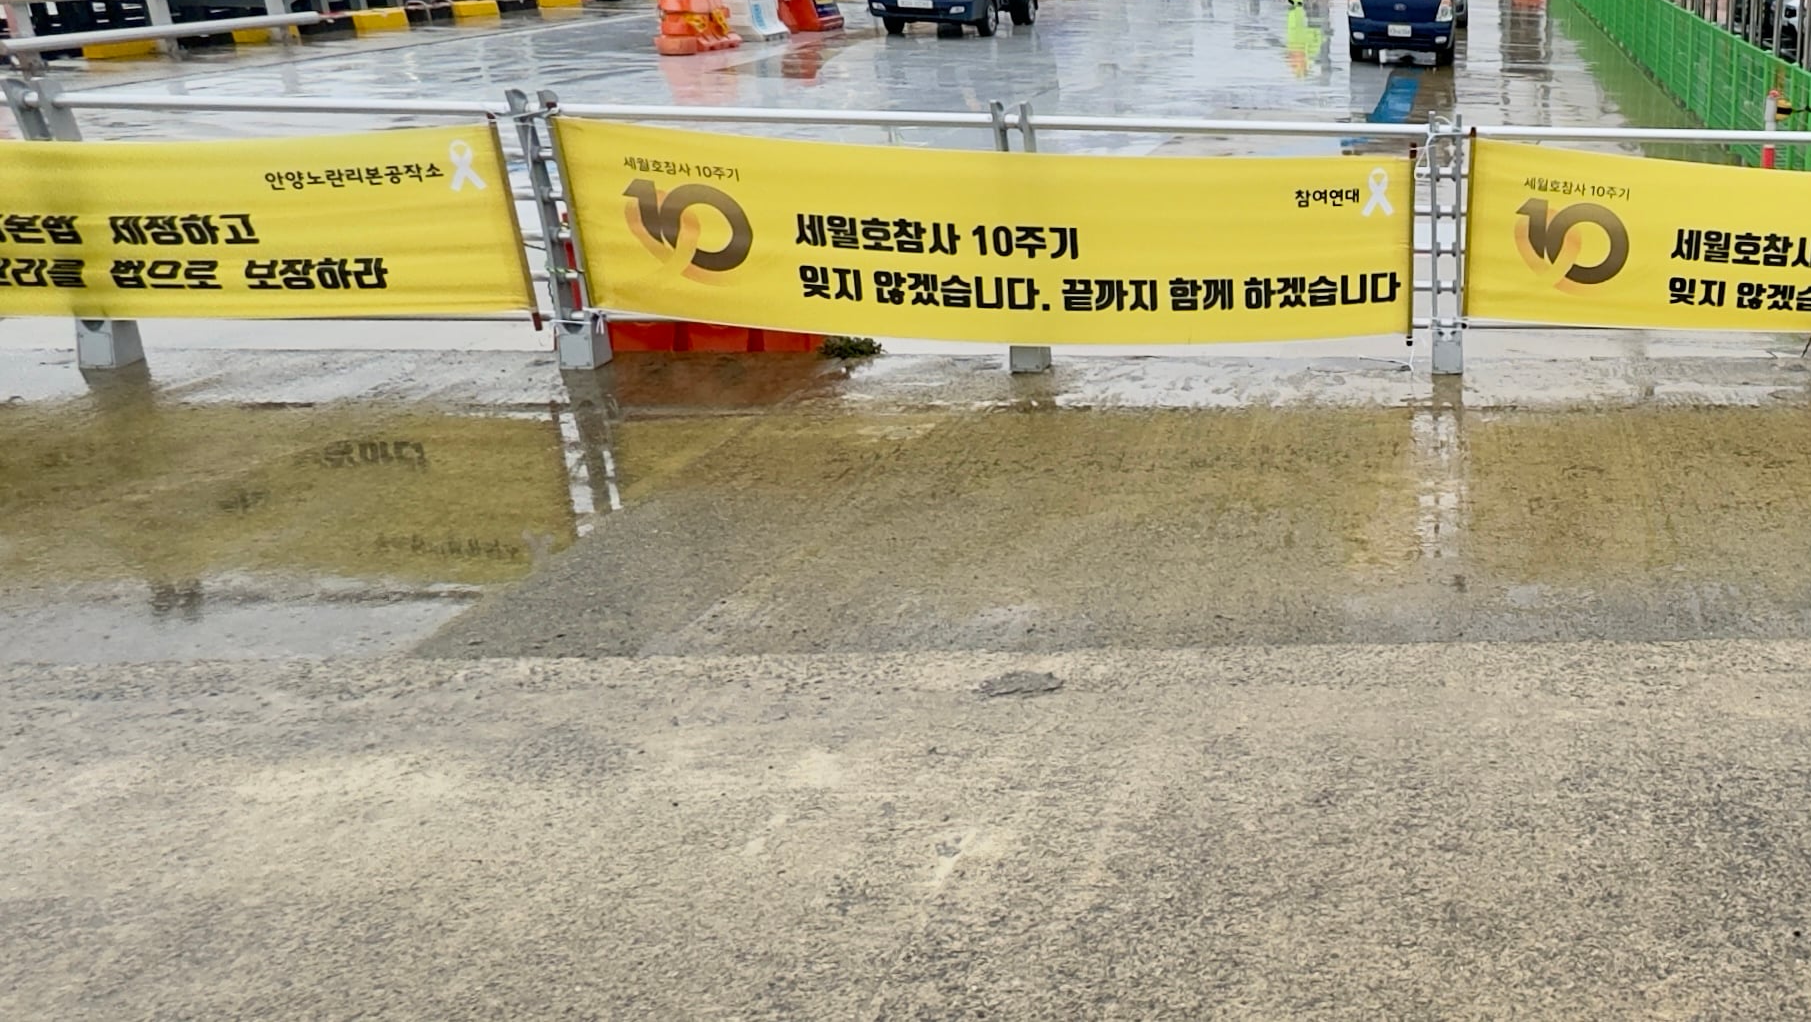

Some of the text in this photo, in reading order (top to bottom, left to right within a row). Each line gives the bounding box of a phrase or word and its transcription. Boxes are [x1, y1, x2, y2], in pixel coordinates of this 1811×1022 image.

[264, 162, 444, 191] 안양노란리본공작소
[623, 156, 740, 182] 세월호참사 10주기
[1295, 188, 1360, 208] 참여연대
[1523, 177, 1630, 201] 세월호참사 10주기
[0, 213, 260, 246] 본법 제정하고
[795, 213, 1079, 260] 세월호참사 10주기
[109, 259, 223, 290] 법으로
[244, 257, 389, 290] 보장하라
[798, 264, 1402, 312] 잊지 않겠습니다. 끝까지 함께 하겠습니다
[1668, 276, 1727, 308] 잊지
